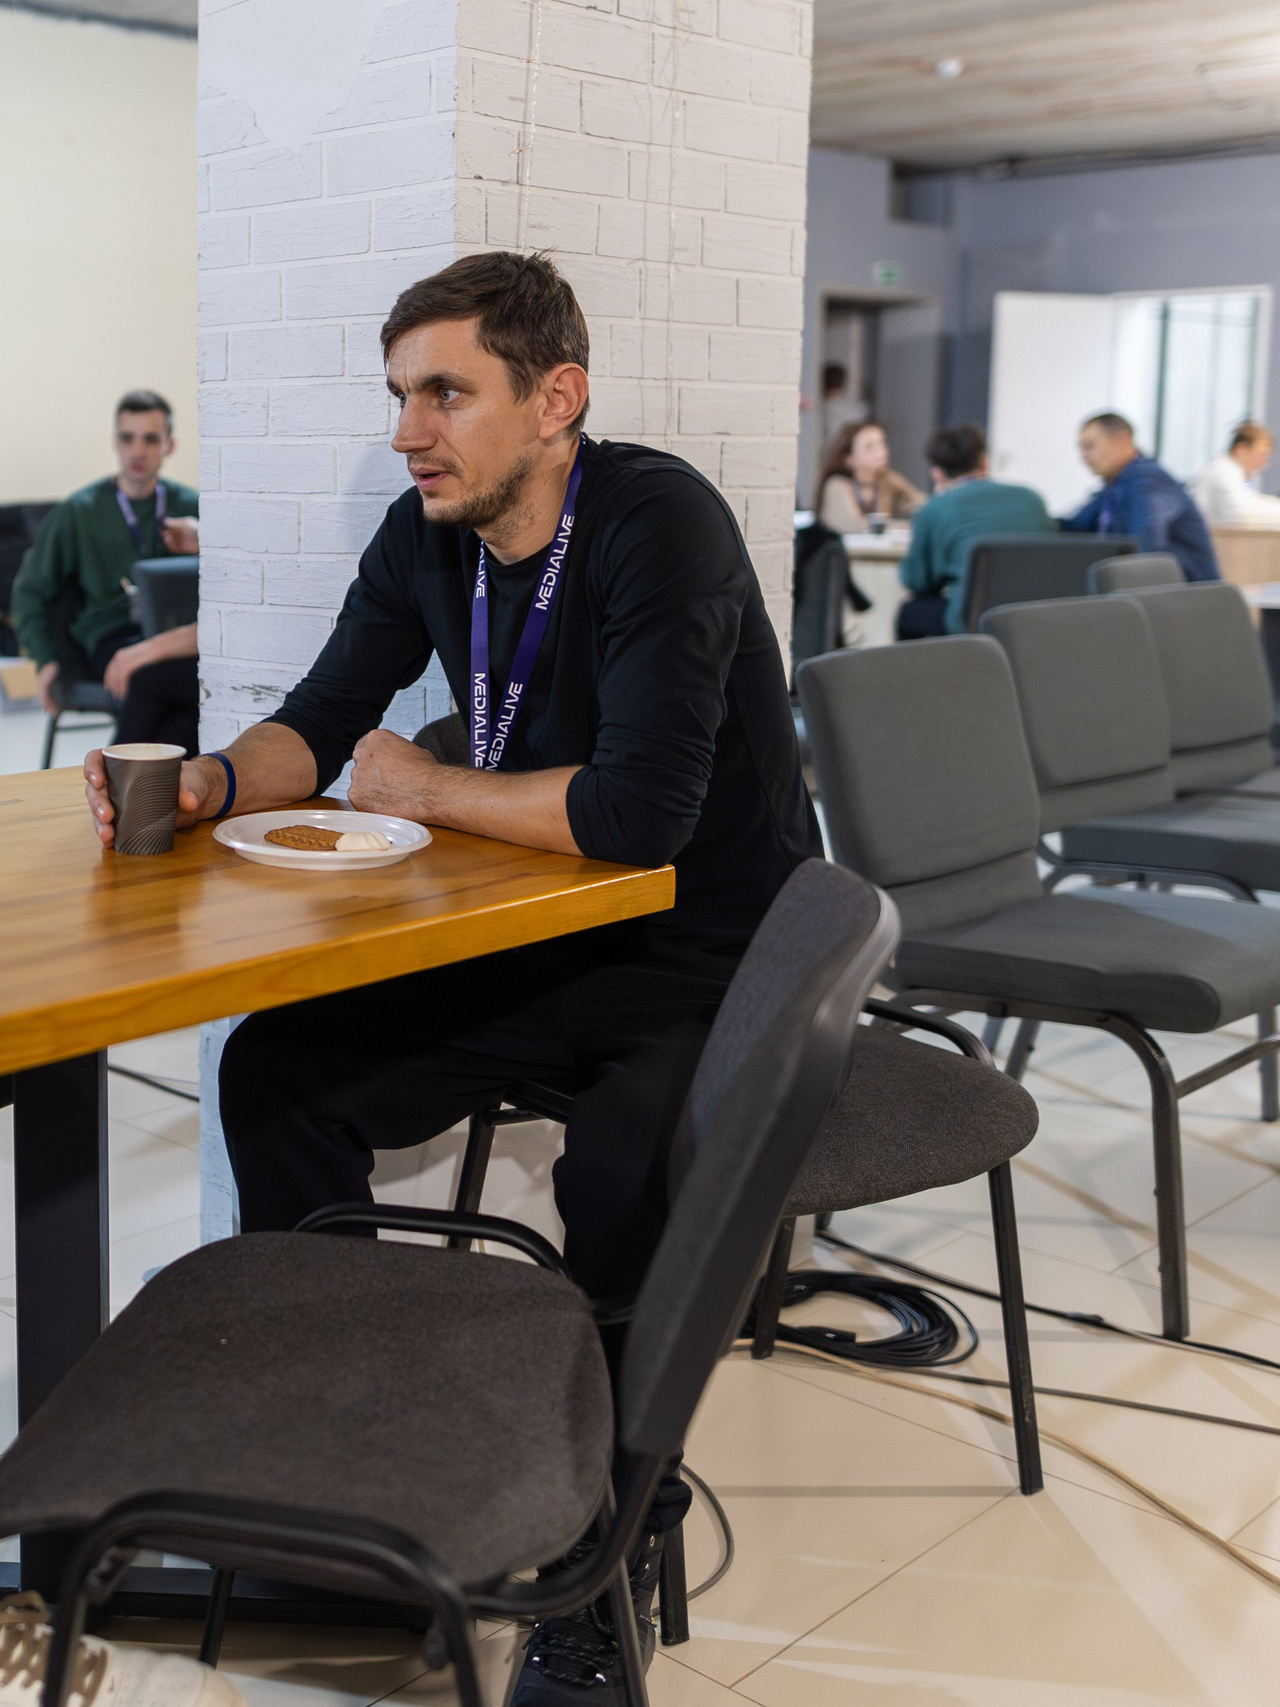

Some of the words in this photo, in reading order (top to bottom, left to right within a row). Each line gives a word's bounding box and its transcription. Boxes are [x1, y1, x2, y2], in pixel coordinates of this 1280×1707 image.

[476, 543, 485, 598] ALIVE
[535, 514, 575, 610] MEDIALIVE
[474, 673, 487, 768] MEDIALIVE
[485, 681, 523, 772] MEDIALIVE
